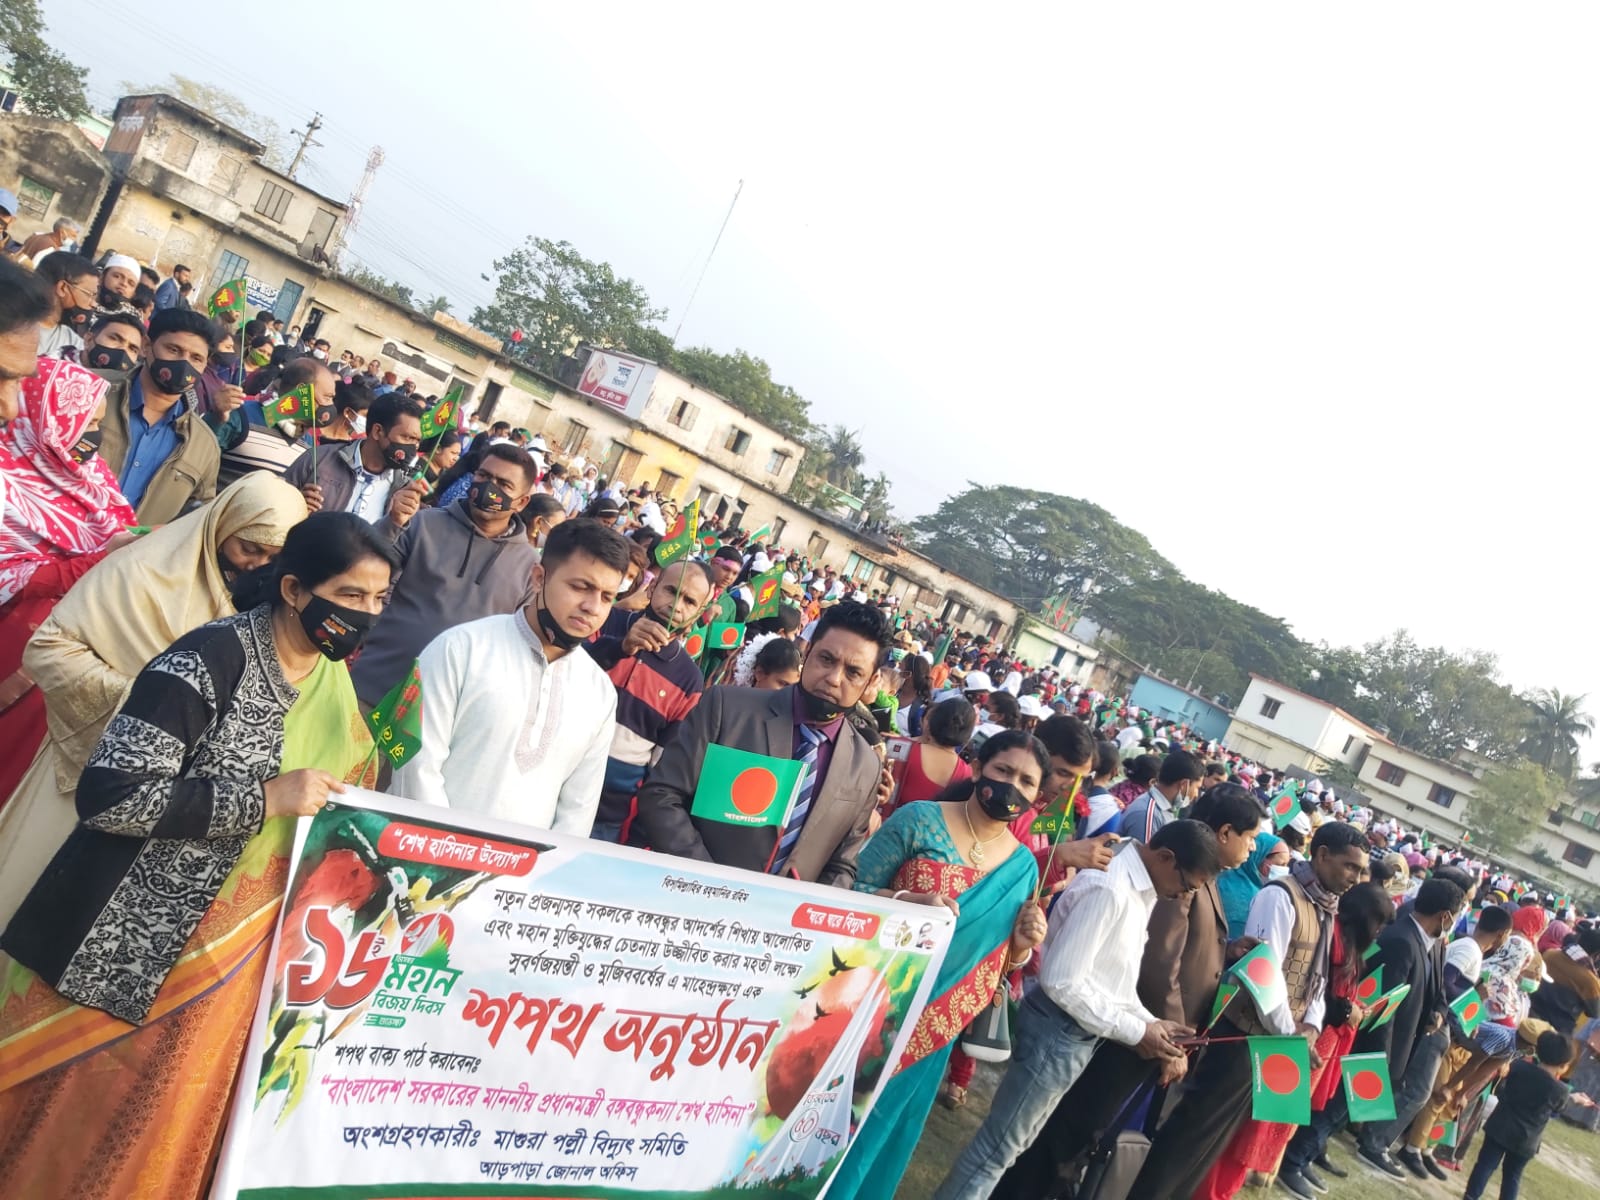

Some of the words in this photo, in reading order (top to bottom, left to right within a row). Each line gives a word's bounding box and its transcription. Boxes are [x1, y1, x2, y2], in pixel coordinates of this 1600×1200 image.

[429, 835, 478, 863] হাসিনার
[494, 889, 527, 913] নতুন
[528, 894, 585, 919] প্রজন্মসহ
[586, 902, 634, 924] সকলকে
[636, 911, 681, 936] বঙ্গবন্ধুর
[682, 919, 727, 940] আদর্শের
[727, 922, 760, 946] শিখায়
[762, 932, 813, 953] আলোকিত
[827, 913, 844, 929] ঘরে
[483, 918, 513, 942] এবং
[516, 922, 551, 944] মহান
[553, 924, 614, 952] মুক্তিযুদ্ধের
[615, 936, 661, 957] চেতনায়
[662, 941, 711, 965] উজ্জীবিত
[712, 951, 741, 968] করার
[743, 953, 773, 976] মহতী
[384, 960, 464, 998] মহান
[508, 949, 580, 977] সুবর্ণজয়ন্তী
[583, 962, 596, 978] ও
[598, 959, 667, 987] মুজিববর্ষের
[667, 974, 680, 991] এ
[681, 976, 742, 998] মাহেন্দ্রক্ষণে
[743, 985, 764, 1000] এক
[371, 990, 412, 1013] বিজয়
[412, 995, 447, 1017] দিবস
[461, 988, 606, 1059] শপথ
[603, 999, 782, 1081] অনুষ্ঠান
[335, 1044, 367, 1065] শপথ
[369, 1046, 401, 1067] বাক্য
[403, 1042, 429, 1069] পাঠ
[321, 1074, 406, 1107] “বাংলাদেশ
[407, 1080, 482, 1107] সরকারের
[482, 1082, 538, 1114] মাননীয়
[538, 1088, 605, 1118] প্রধানমন্ত্রী
[605, 1097, 678, 1127] বঙ্গবন্ধুকন্যা
[675, 1101, 706, 1122] শেখ
[494, 1127, 548, 1151] মাগুরা
[552, 1127, 588, 1155] পল্লী
[590, 1129, 635, 1160] বিদ্যুৎ
[639, 1131, 689, 1157] সমিতি
[480, 1160, 543, 1182] আড়পাড়া
[546, 1162, 595, 1181] জোনাল
[599, 1160, 639, 1182] অফিস
